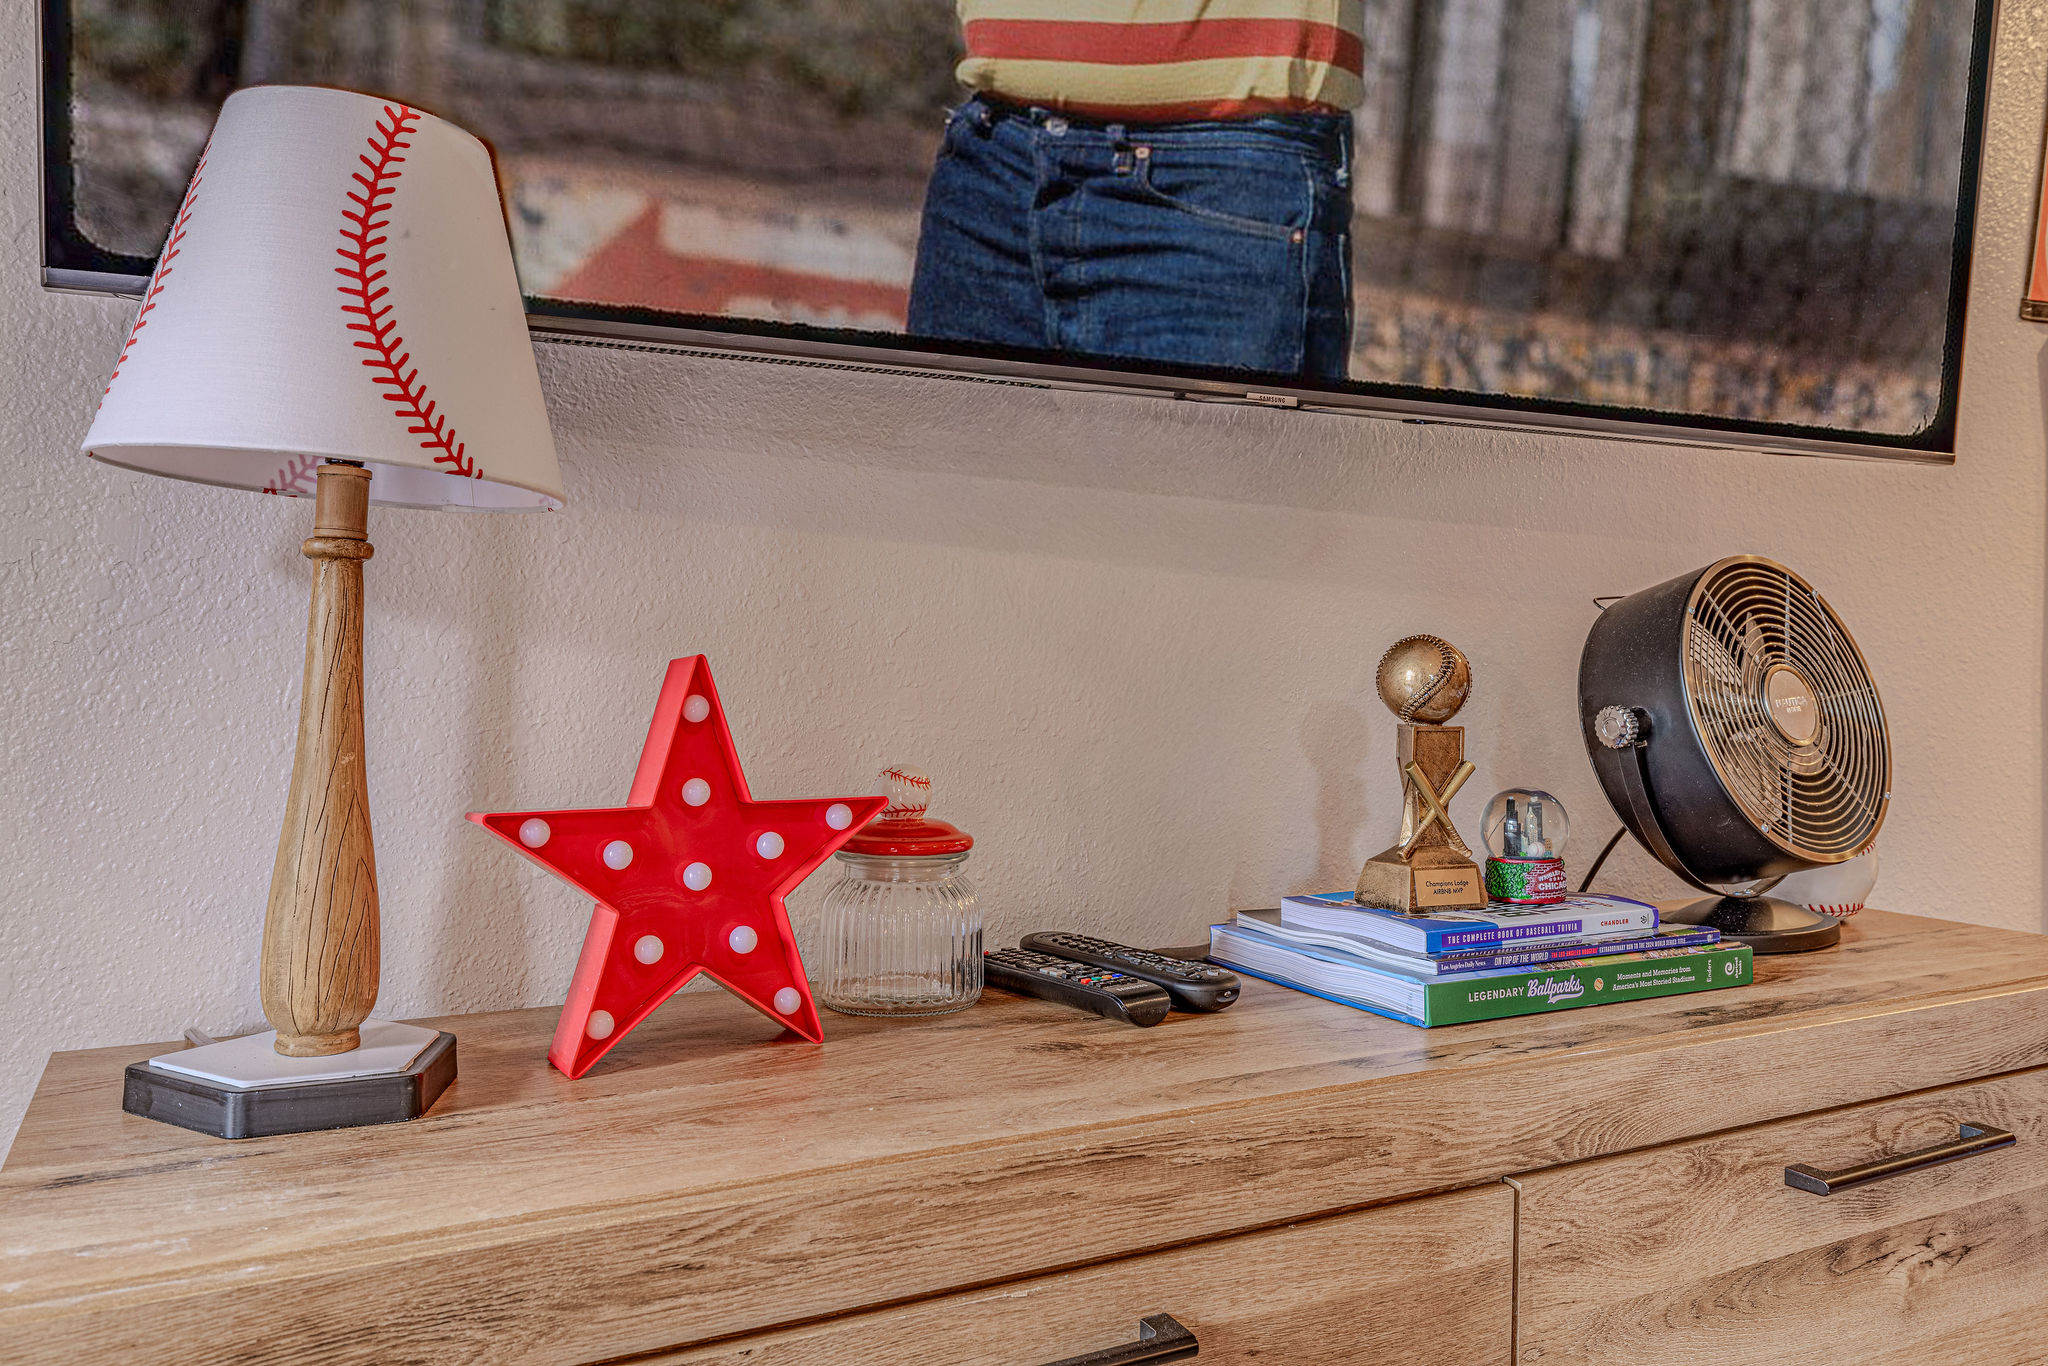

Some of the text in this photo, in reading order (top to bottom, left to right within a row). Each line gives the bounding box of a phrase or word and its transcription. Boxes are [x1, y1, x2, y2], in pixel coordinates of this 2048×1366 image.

[1260, 395, 1286, 404] SAMSUNG
[1425, 879, 1469, 888] Champions Lodge
[1538, 881, 1567, 890] CHICAG
[1600, 918, 1629, 927] CHANDLER
[1448, 923, 1578, 945] THE COMPLETE BOOK OF BASEBALL TRIVIA
[1494, 957, 1503, 966] ON
[1502, 956, 1512, 966] TOP
[1512, 955, 1520, 964] OF
[1520, 954, 1529, 963] THE
[1530, 952, 1549, 962] WORLD
[1450, 962, 1464, 971] Angeles
[1464, 960, 1475, 969] Daily
[1616, 972, 1642, 981] Moments
[1642, 970, 1652, 978] and
[1652, 968, 1678, 976] Memories
[1468, 972, 1585, 1004] LEGENDARY Ballparks
[1612, 982, 1639, 991] America's
[1652, 978, 1672, 986] Storied
[1672, 976, 1696, 984] Stadiums
